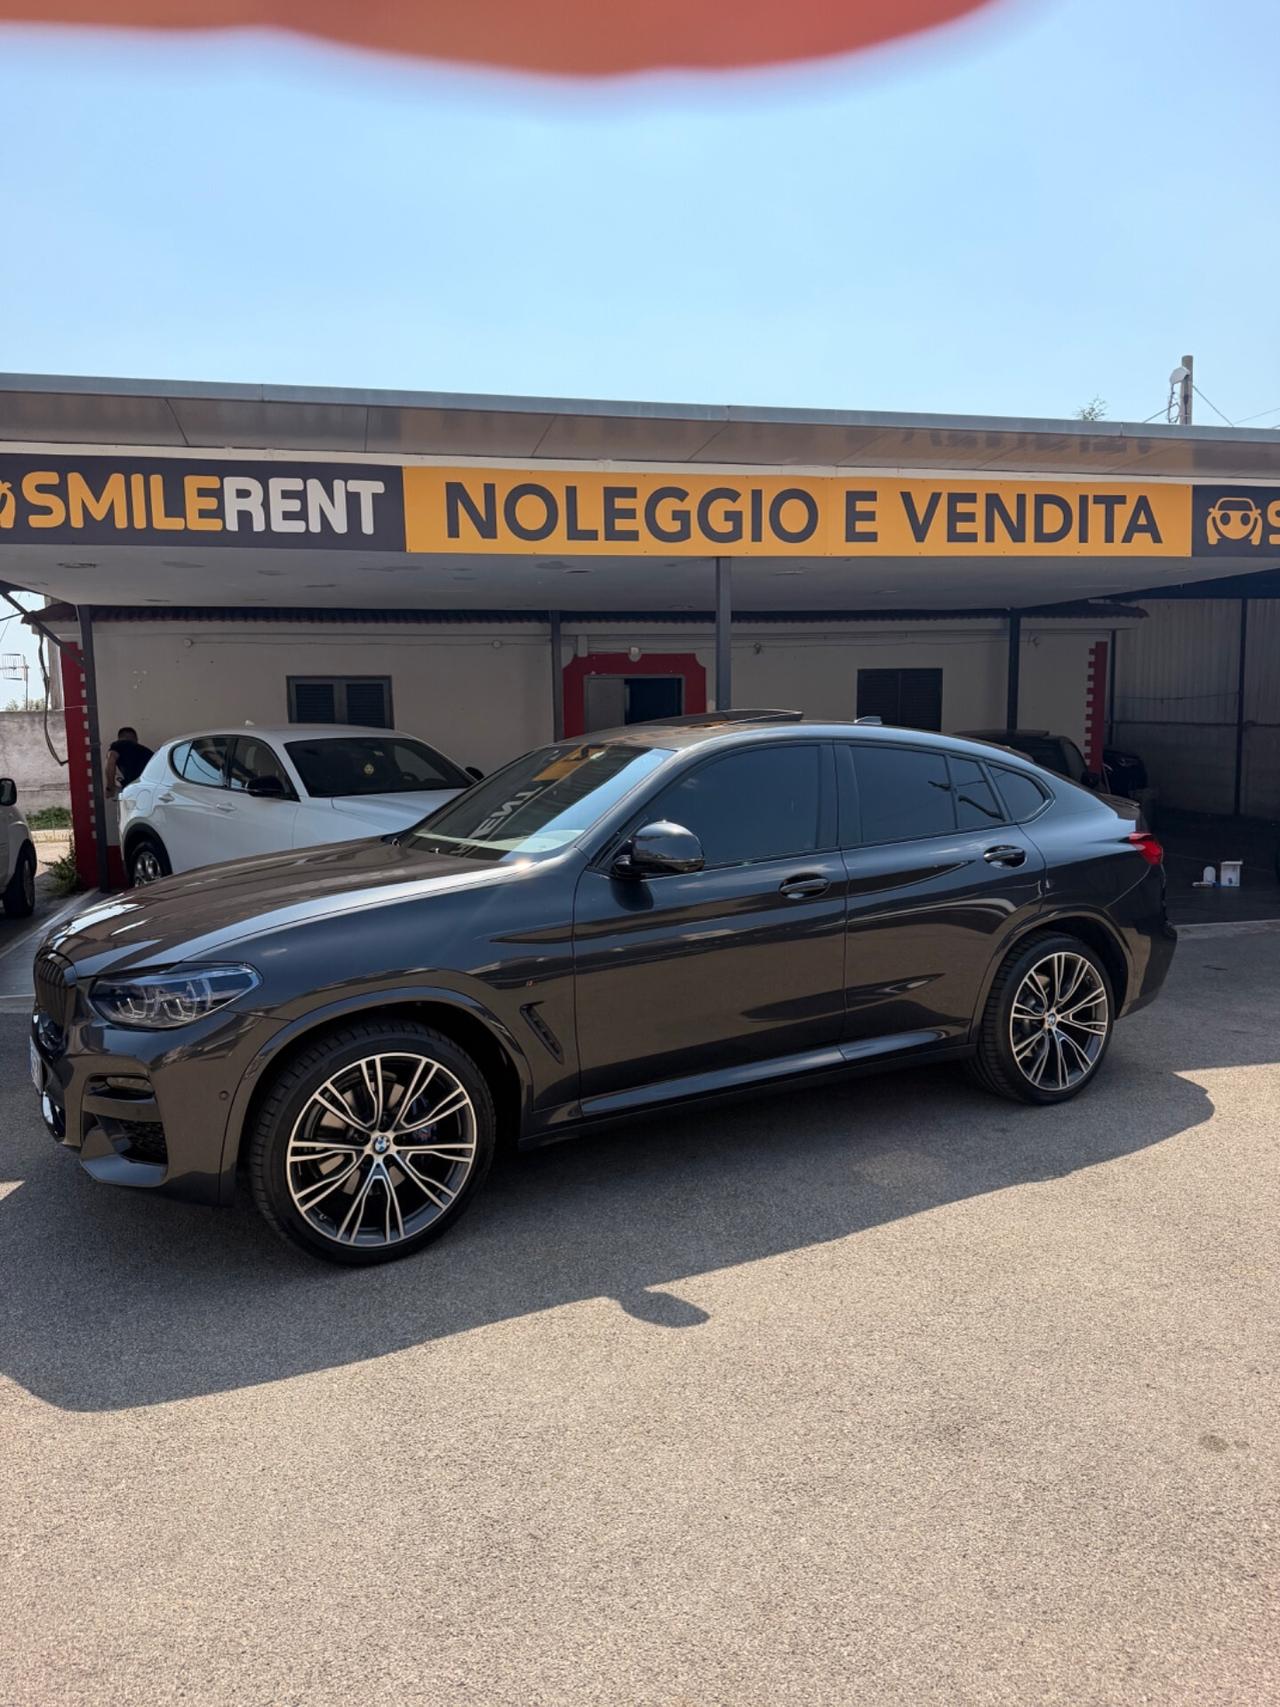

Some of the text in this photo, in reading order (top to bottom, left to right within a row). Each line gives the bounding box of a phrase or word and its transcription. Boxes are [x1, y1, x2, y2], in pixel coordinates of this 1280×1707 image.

[21, 471, 385, 535] SMILERENT
[445, 481, 1163, 544] NOLEGGIO E VENDITA
